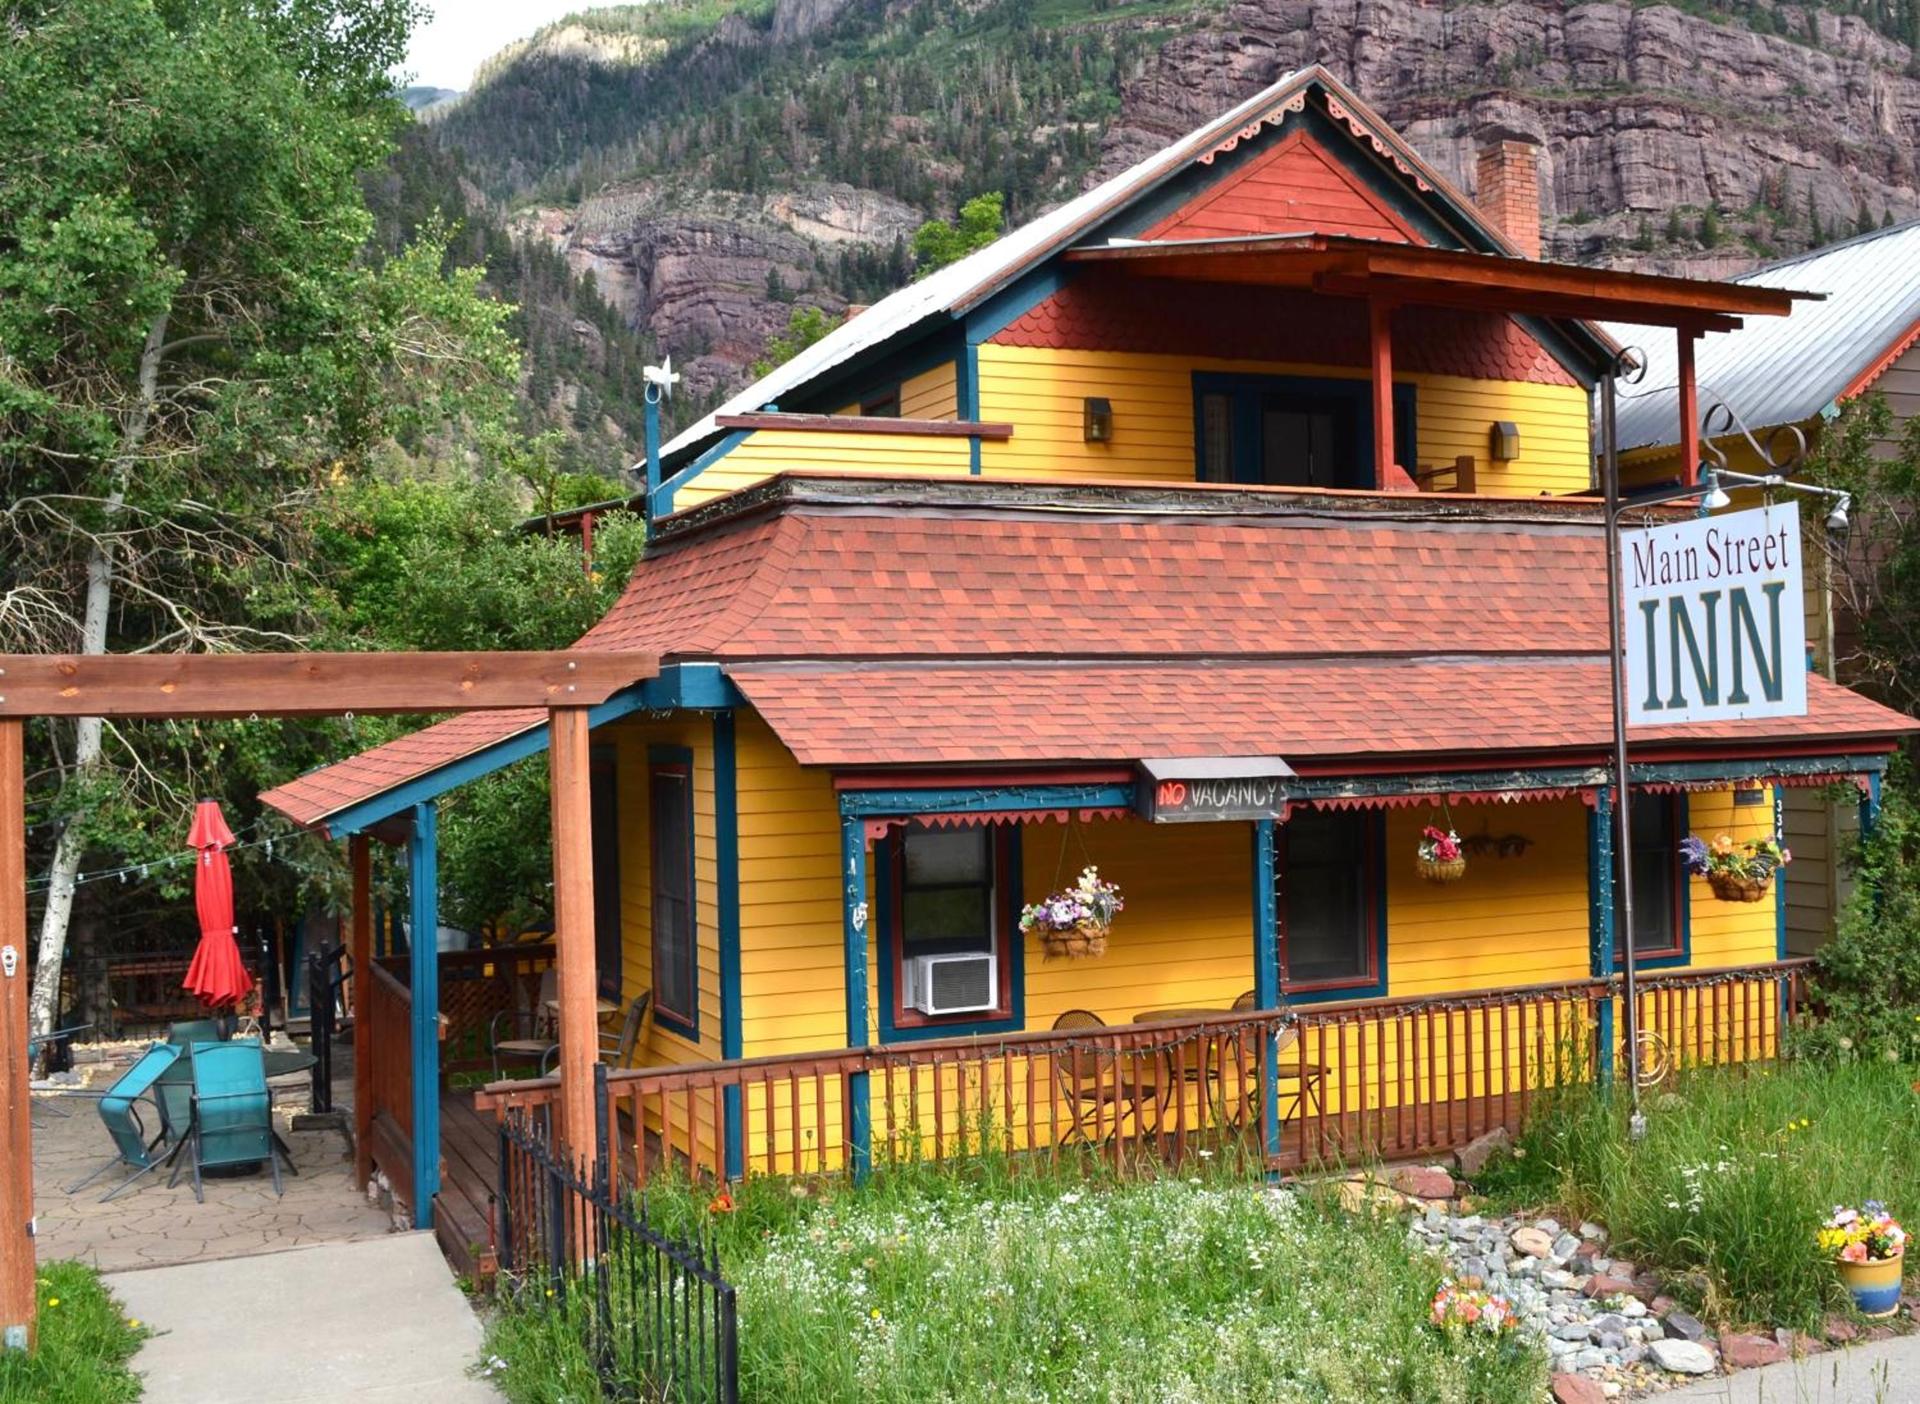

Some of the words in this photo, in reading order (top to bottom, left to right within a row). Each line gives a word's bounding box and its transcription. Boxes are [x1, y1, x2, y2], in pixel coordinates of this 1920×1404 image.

[1631, 534, 1699, 589] Main
[1706, 524, 1789, 579] Street
[1638, 580, 1785, 712] INN
[1159, 783, 1185, 806] NO
[1191, 779, 1277, 808] VACANCY
